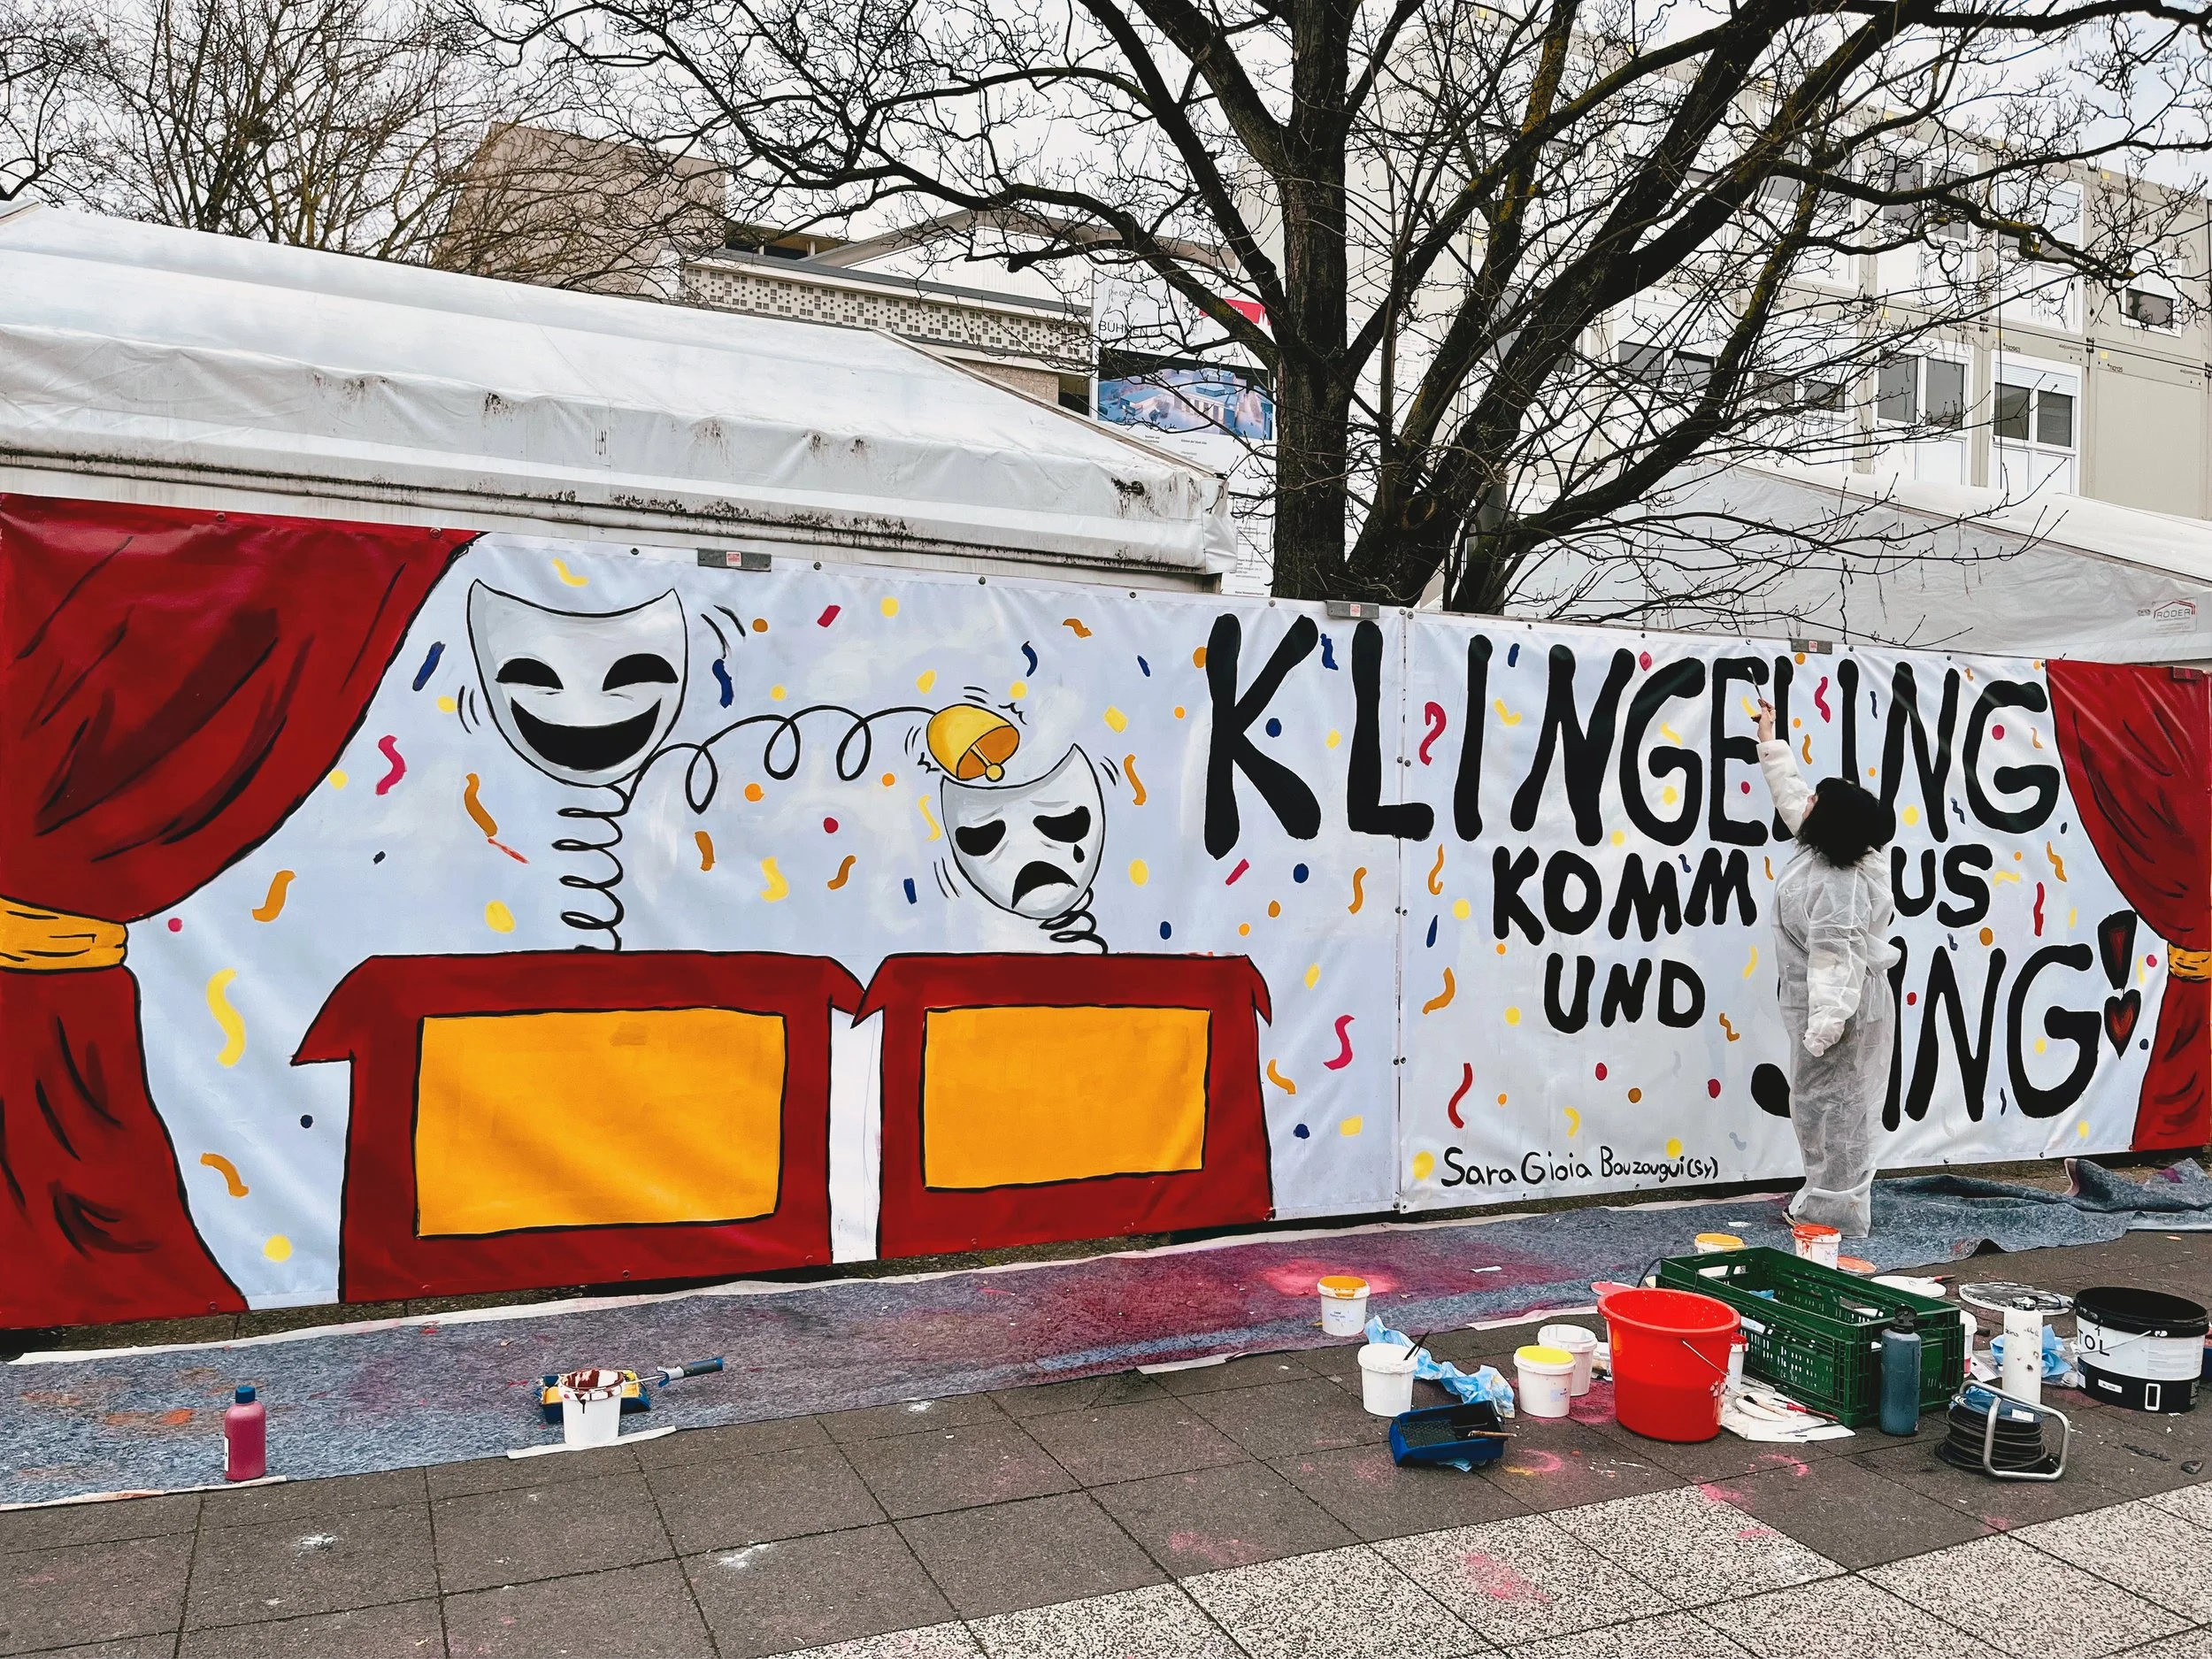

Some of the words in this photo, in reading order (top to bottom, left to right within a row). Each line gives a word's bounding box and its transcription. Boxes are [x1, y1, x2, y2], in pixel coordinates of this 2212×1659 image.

[1493, 846, 1757, 946] KOMM
[1887, 843, 1993, 928] US
[1544, 952, 1706, 1033] UND
[1751, 910, 2141, 1131] ING!
[1440, 1147, 1517, 1187] Sara
[1520, 1151, 1592, 1185] Gioia
